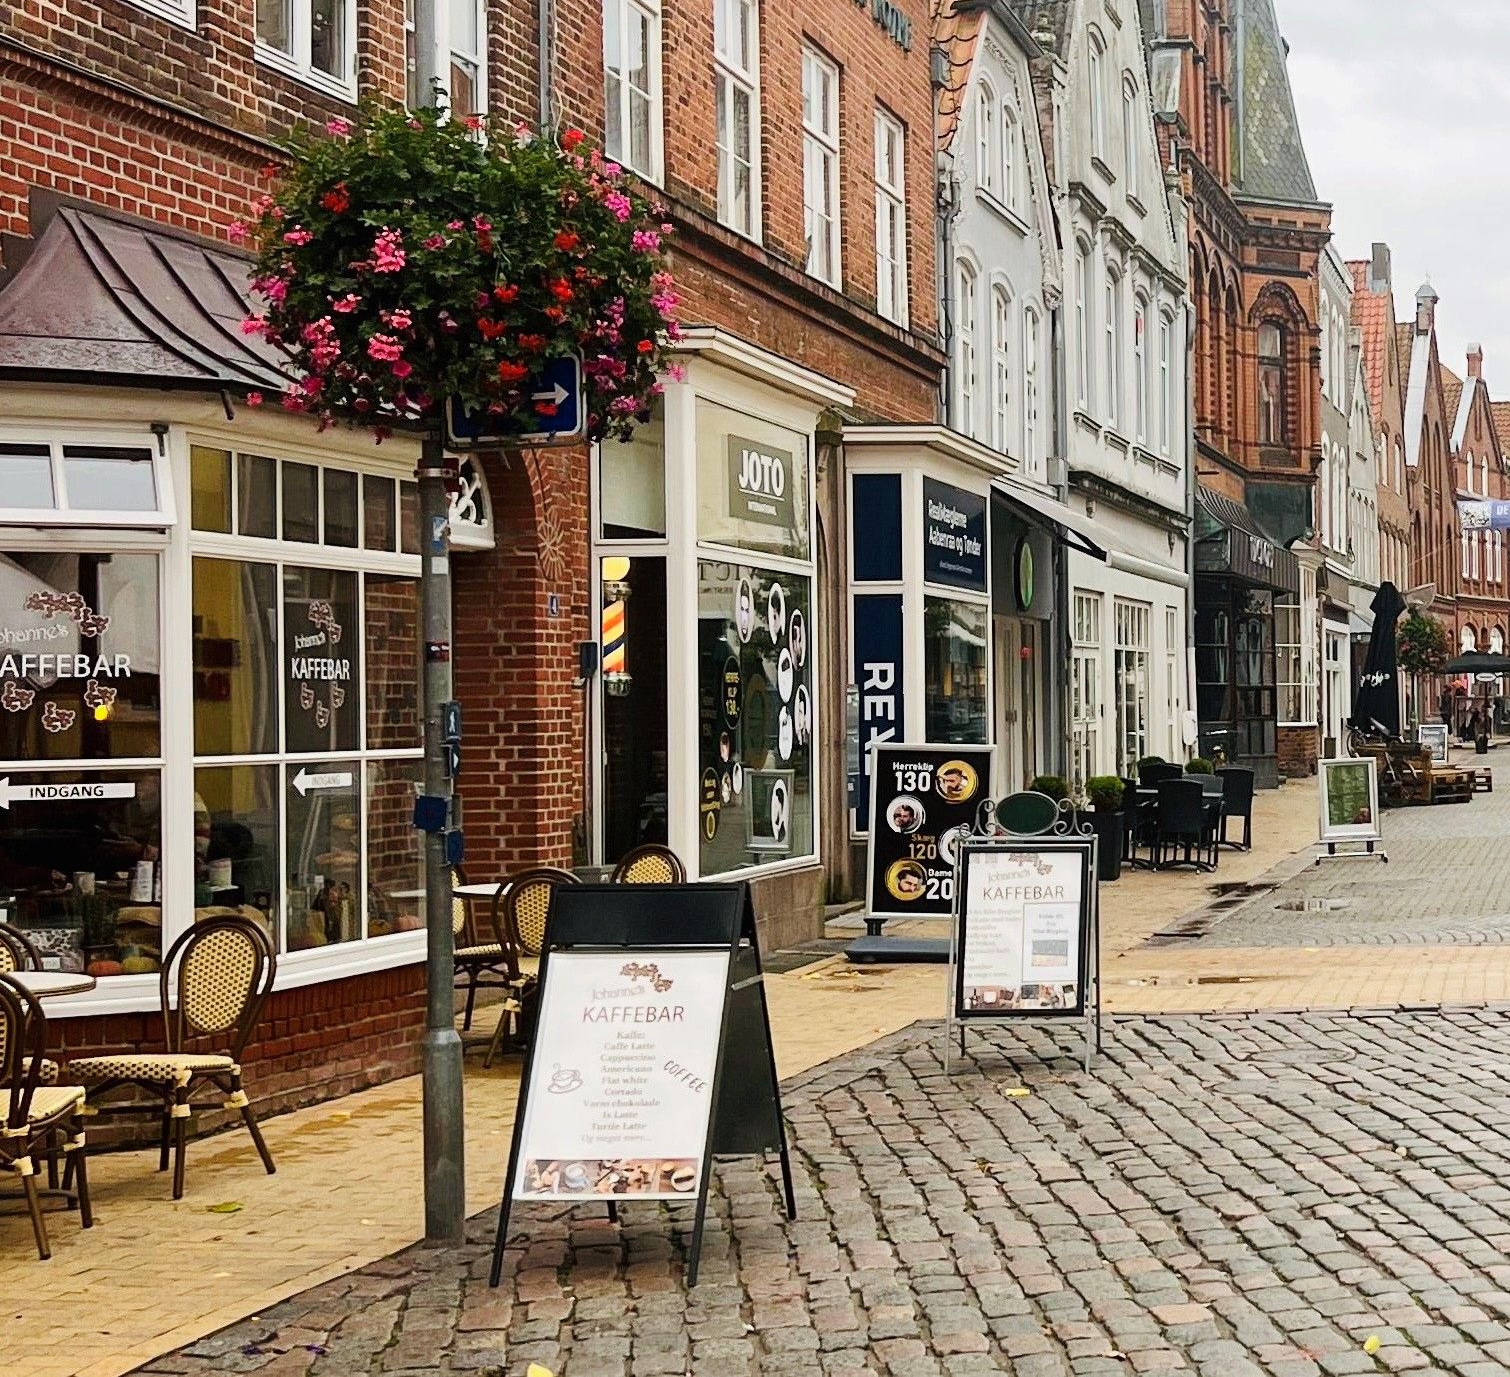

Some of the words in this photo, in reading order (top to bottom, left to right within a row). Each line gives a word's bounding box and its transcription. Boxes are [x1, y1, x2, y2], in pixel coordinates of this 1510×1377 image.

[739, 449, 784, 497] JOTO
[929, 525, 955, 549] Aabenraa
[956, 536, 963, 556] og
[0, 624, 69, 644] ohanne's
[0, 654, 131, 678] AFFEBAR
[291, 658, 350, 681] KAFFEBAR
[30, 786, 104, 798] INDGANG
[895, 771, 931, 792] 130
[908, 844, 937, 860] 120
[983, 886, 1064, 900] KAFFEBAR
[582, 1005, 684, 1023] KAFFEBAR
[664, 1060, 706, 1093] COFFEE
